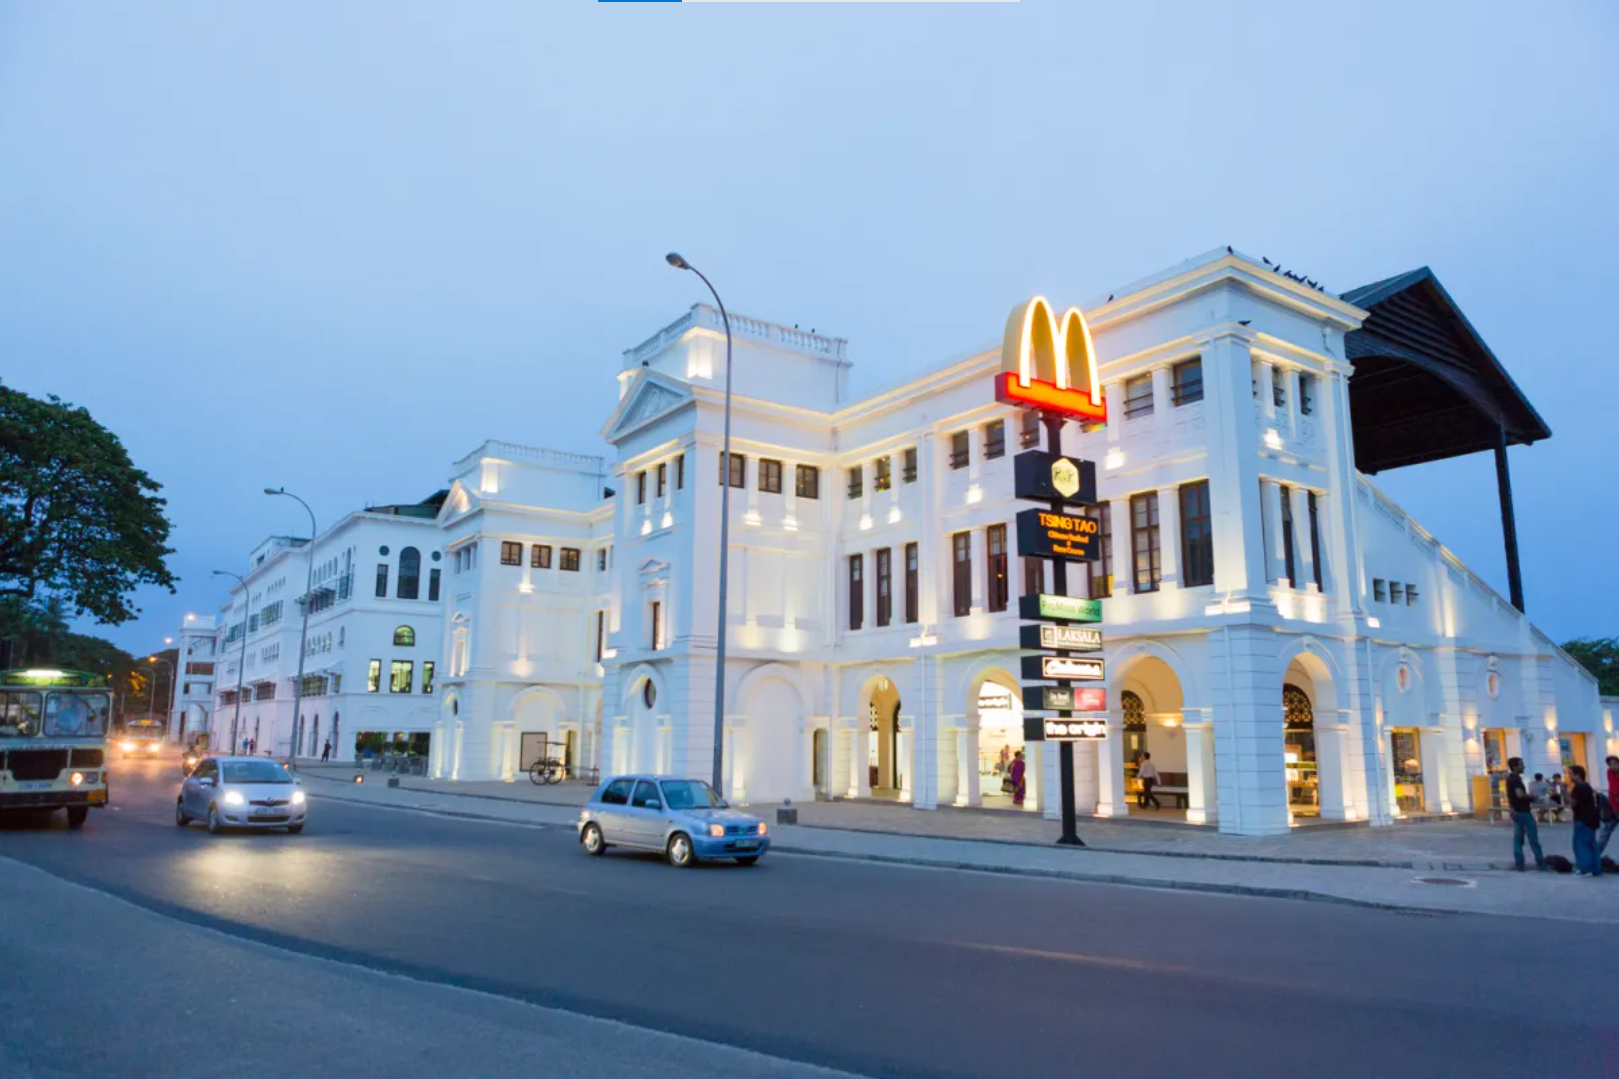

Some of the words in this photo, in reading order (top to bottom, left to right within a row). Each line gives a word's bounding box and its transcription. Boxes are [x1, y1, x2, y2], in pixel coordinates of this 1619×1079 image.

[1057, 628, 1102, 643] LAKSALA
[1046, 721, 1067, 735] the
[1068, 721, 1107, 737] origin
